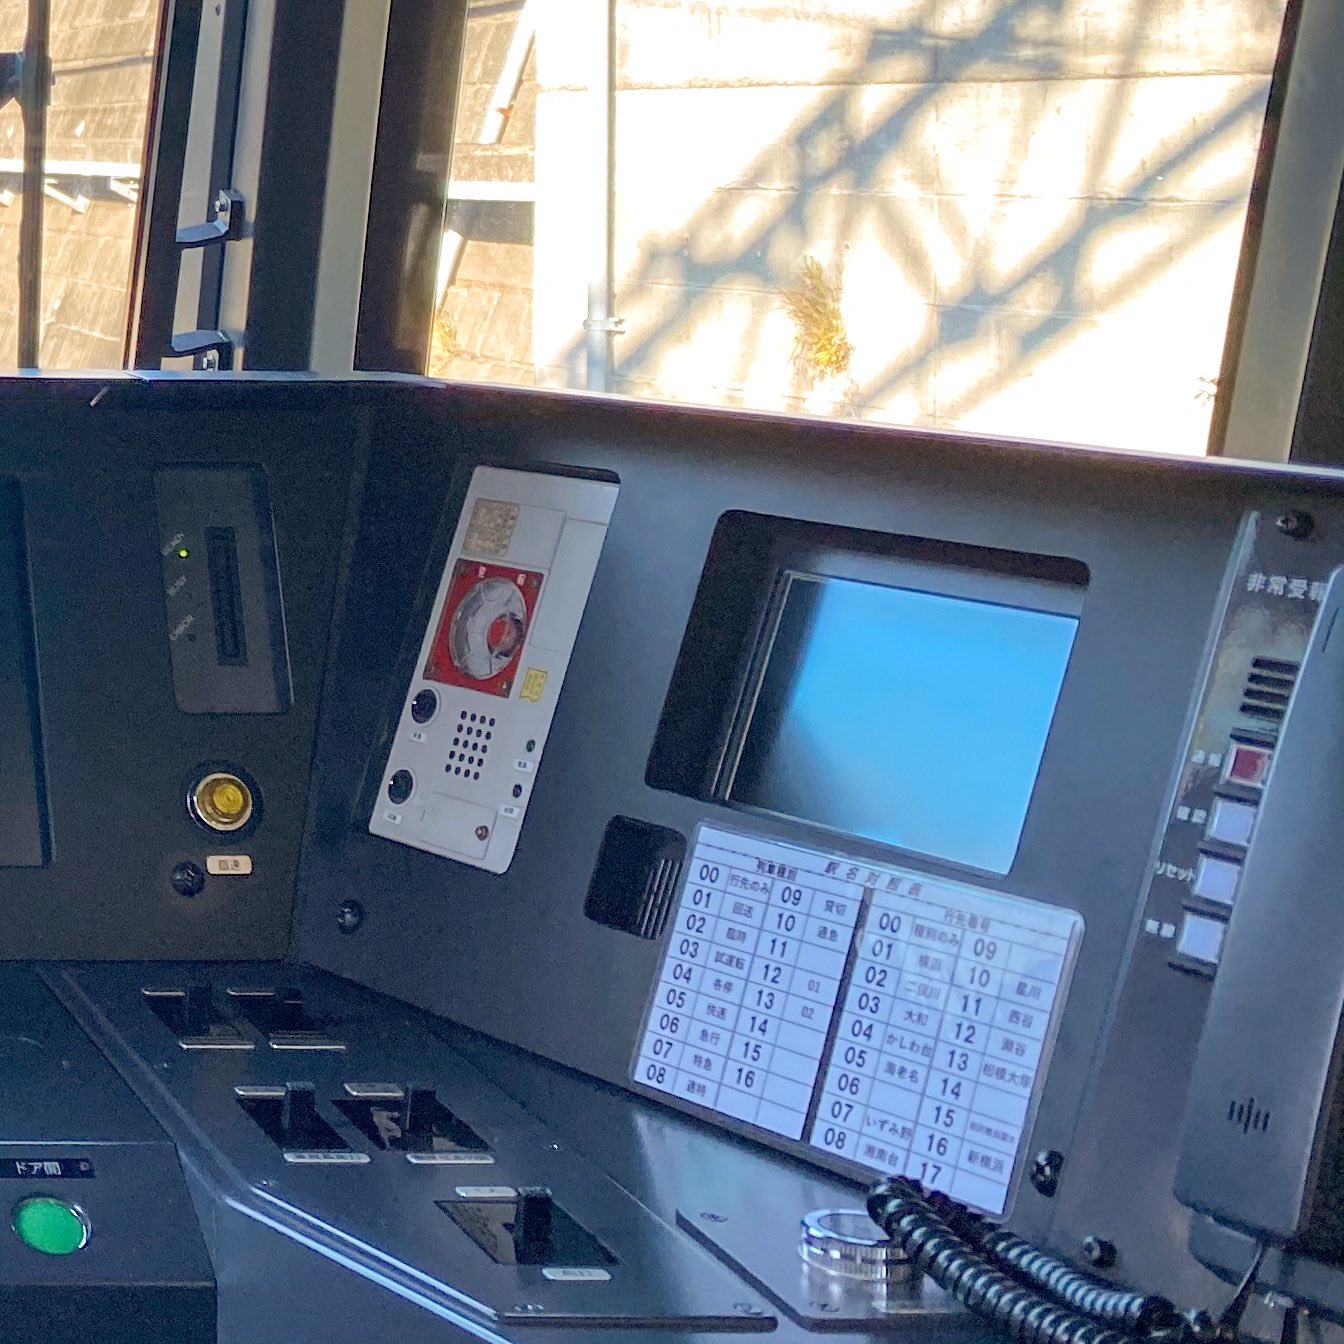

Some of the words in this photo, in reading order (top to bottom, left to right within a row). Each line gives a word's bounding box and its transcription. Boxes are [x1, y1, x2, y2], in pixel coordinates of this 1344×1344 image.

[699, 865, 719, 883] 00
[730, 875, 770, 895] 行先のみ
[781, 886, 802, 906] 09
[824, 900, 846, 915] 貸切
[1154, 862, 1195, 883] リセット
[693, 889, 711, 908] 01
[732, 902, 753, 918] 回送
[777, 913, 795, 931] 10
[686, 914, 706, 933] 02
[771, 938, 787, 957] 11
[879, 913, 901, 933] 00
[974, 938, 997, 960] 09
[680, 939, 699, 958] 03
[715, 951, 745, 969] 試運転
[764, 965, 781, 984] 12
[872, 940, 893, 960] 01
[968, 966, 990, 987] 10
[673, 964, 691, 983] 04
[713, 979, 733, 993] 各停
[757, 990, 774, 1009] 13
[865, 966, 887, 987] 02
[962, 994, 981, 1016] 11
[1009, 1010, 1034, 1028] 西谷
[666, 989, 685, 1008] 05
[750, 1016, 768, 1035] 14
[858, 993, 880, 1014] 03
[904, 1010, 929, 1025] 大和
[955, 1022, 976, 1044] 12
[660, 1014, 679, 1033] 06
[700, 1030, 720, 1045] 急行
[744, 1042, 761, 1062] 15
[851, 1020, 873, 1041] 04
[886, 1034, 934, 1057] かしわ台
[947, 1050, 968, 1071] 13
[646, 1065, 666, 1083] 08
[653, 1039, 673, 1058] 07
[736, 1068, 755, 1088] 16
[844, 1046, 867, 1067] 05
[884, 1062, 919, 1083] 海老名
[941, 1078, 962, 1099] 14
[838, 1074, 860, 1095] 06
[934, 1106, 955, 1127] 15
[824, 1128, 846, 1149] 08
[920, 1162, 941, 1183] 17
[831, 1101, 853, 1122] 07
[865, 1115, 912, 1138] いずみ野
[927, 1134, 948, 1156] 16
[968, 1150, 1004, 1174] 新横浜
[15, 1161, 61, 1175] ドア開
